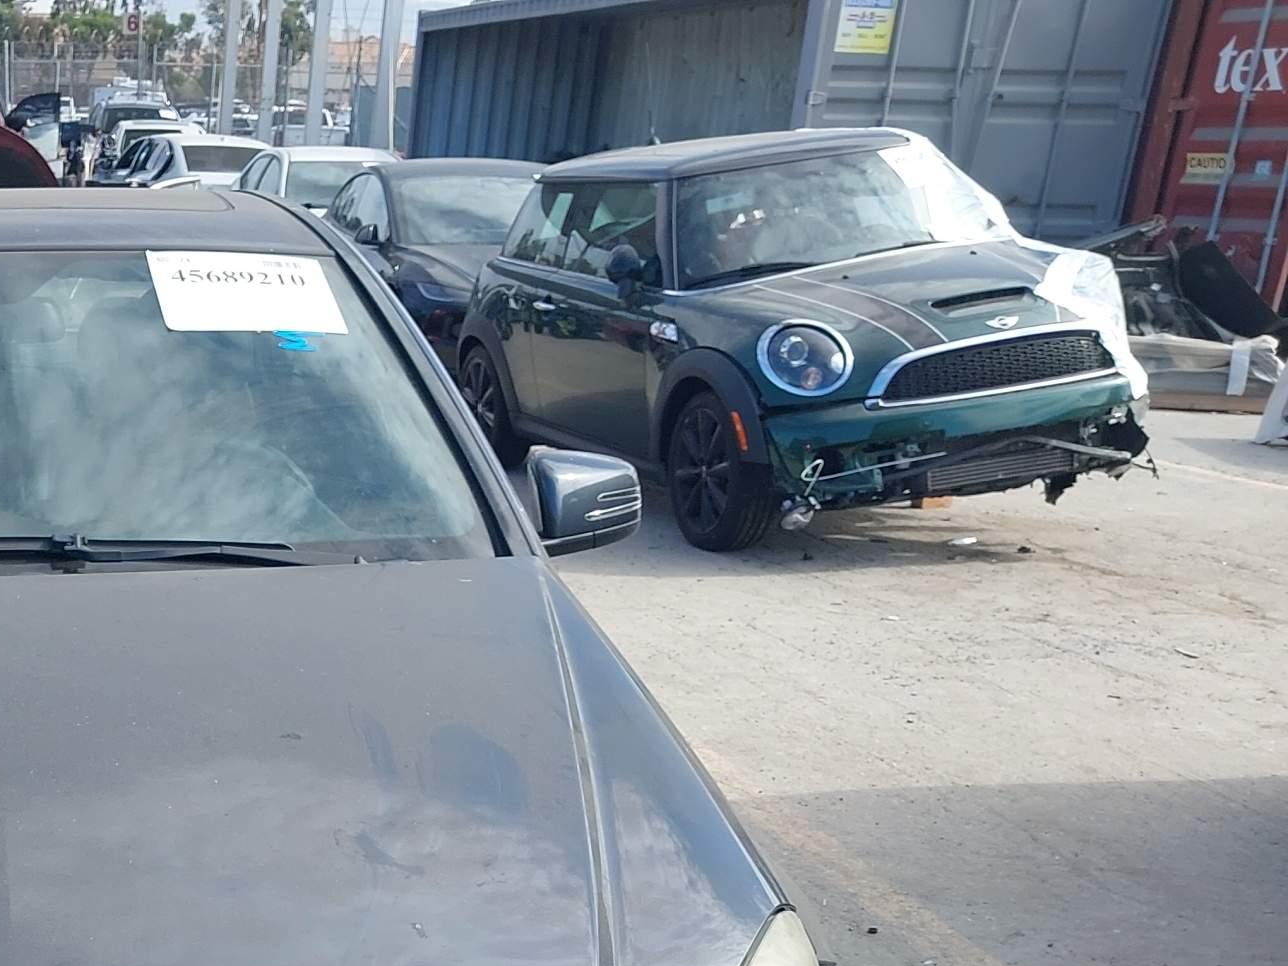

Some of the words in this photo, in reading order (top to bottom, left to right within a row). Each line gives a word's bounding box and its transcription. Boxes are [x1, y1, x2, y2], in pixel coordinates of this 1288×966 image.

[127, 15, 139, 32] 6
[1214, 35, 1288, 94] tex
[1189, 157, 1227, 169] CAUTIO
[171, 268, 306, 287] 45689210
